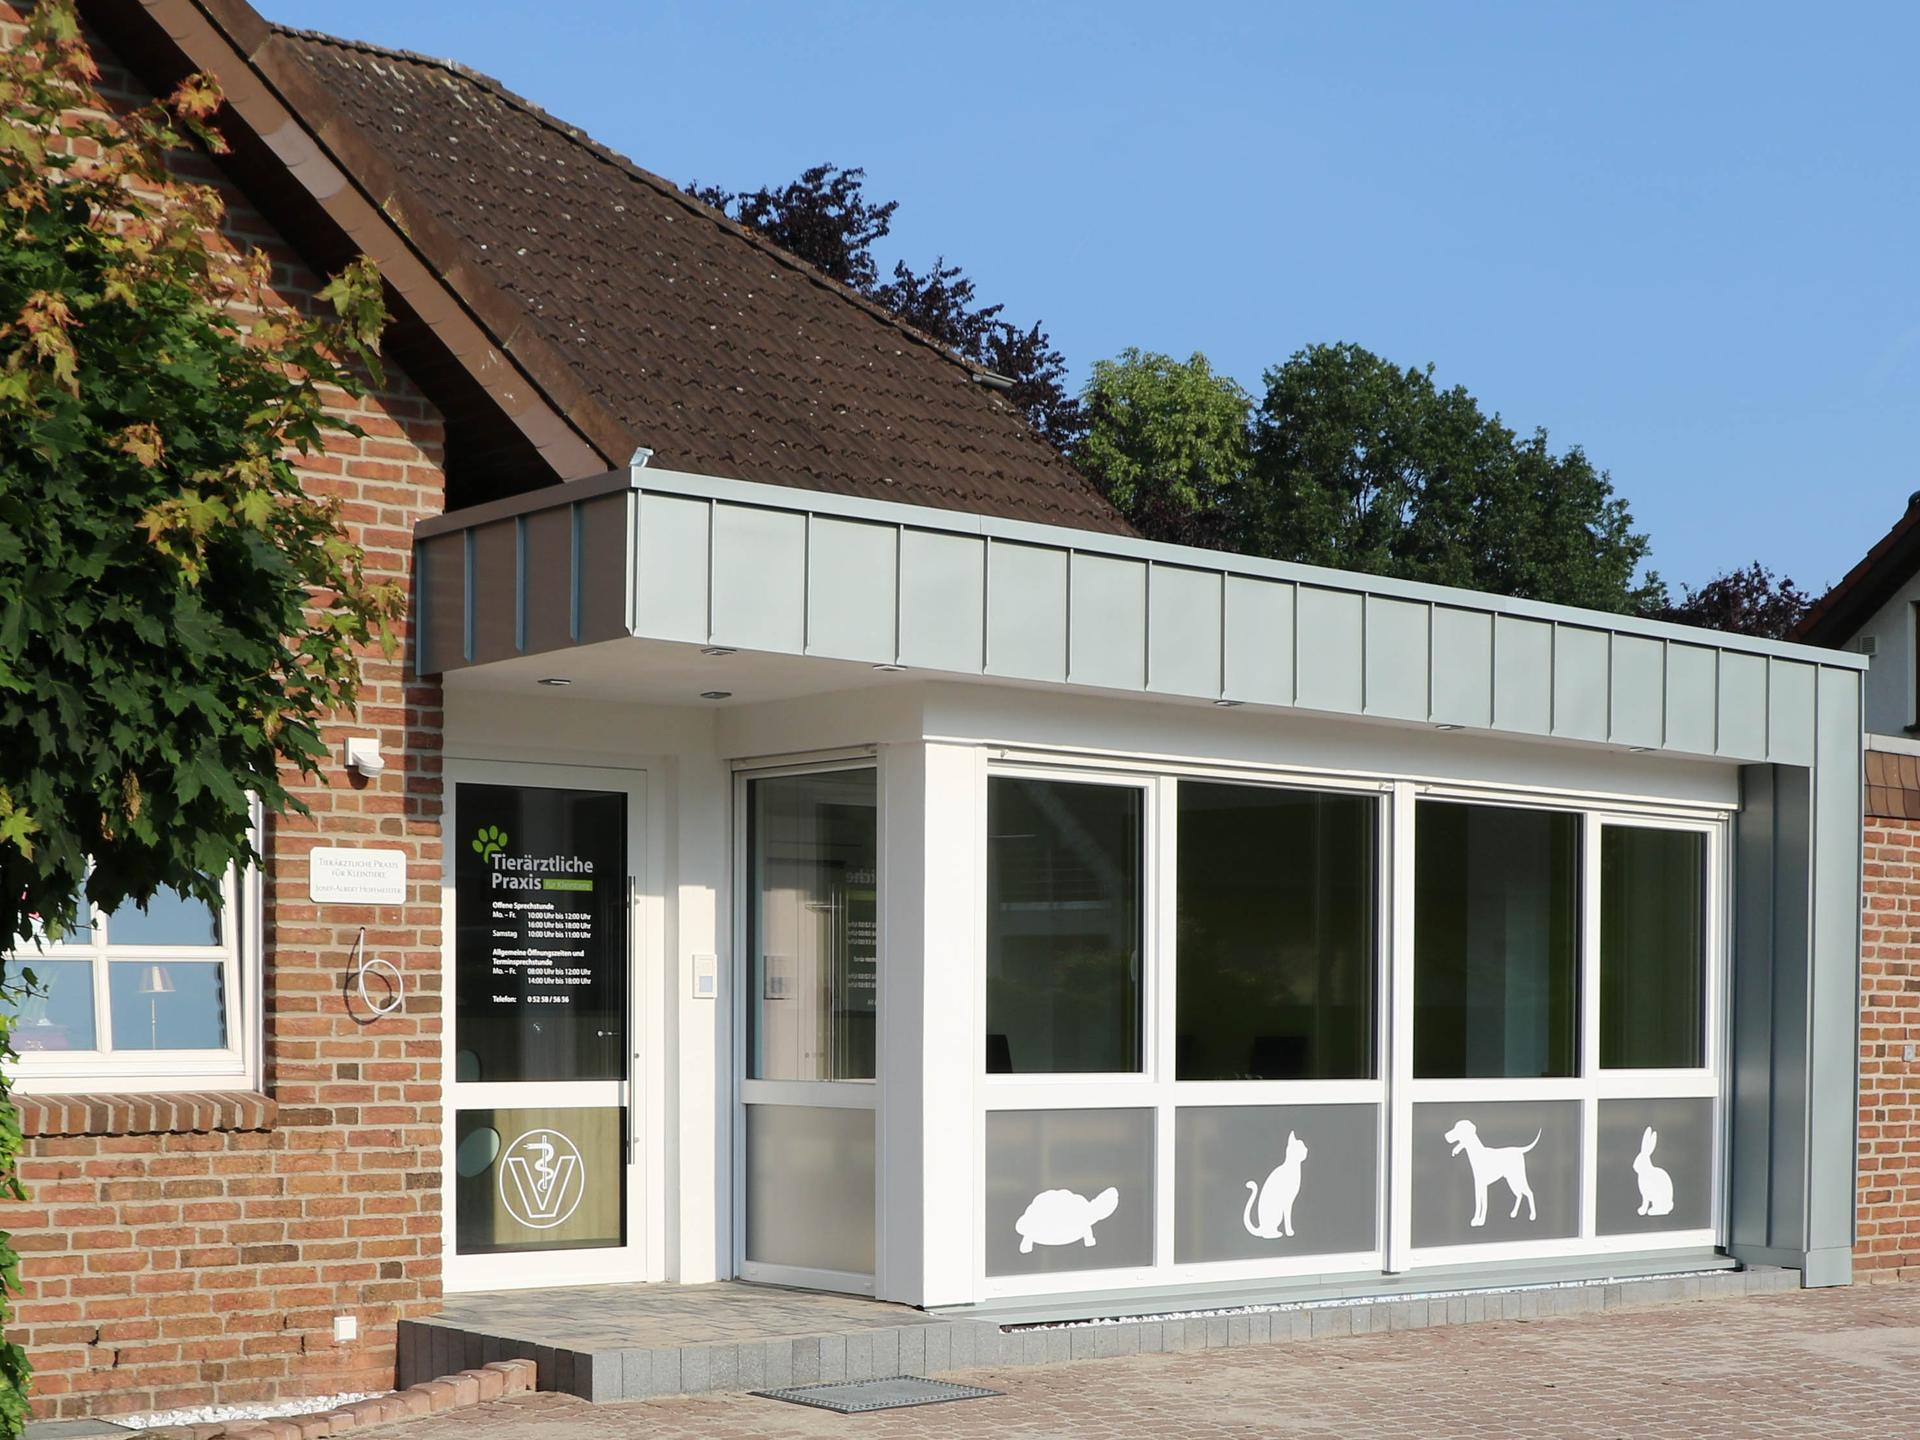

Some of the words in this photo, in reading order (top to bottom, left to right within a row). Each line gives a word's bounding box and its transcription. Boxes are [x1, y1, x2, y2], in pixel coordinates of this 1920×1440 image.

[491, 853, 594, 873] Tierärztliche
[491, 872, 542, 890] Praxis
[492, 901, 513, 909] Offene
[513, 902, 555, 911] Sprechstunde
[492, 910, 504, 919] Mo.
[527, 912, 544, 920] 10:00
[543, 912, 555, 920] Uhr
[564, 912, 581, 920] 12:00
[580, 912, 592, 920] Uhr
[543, 921, 555, 929] Uhr
[580, 922, 592, 930] Uhr
[492, 929, 518, 939] Samstag
[527, 930, 544, 938] 10:00
[543, 930, 555, 938] Uhr
[555, 931, 564, 939] bis
[564, 931, 581, 939] 11:00
[580, 931, 592, 939] Uhr
[492, 948, 527, 958] Allgemeine
[527, 948, 572, 958] Öffnungszeiten
[572, 949, 585, 957] und
[492, 957, 553, 967] Terminsprechstunde
[492, 967, 504, 975] Mo.
[543, 967, 555, 976] Uhr
[555, 967, 564, 976] bis
[564, 967, 581, 976] 12:00
[580, 967, 592, 976] Uhr
[543, 977, 555, 985] Uhr
[555, 977, 564, 985] bis
[580, 977, 592, 985] Uhr
[492, 995, 517, 1003] Telefon:
